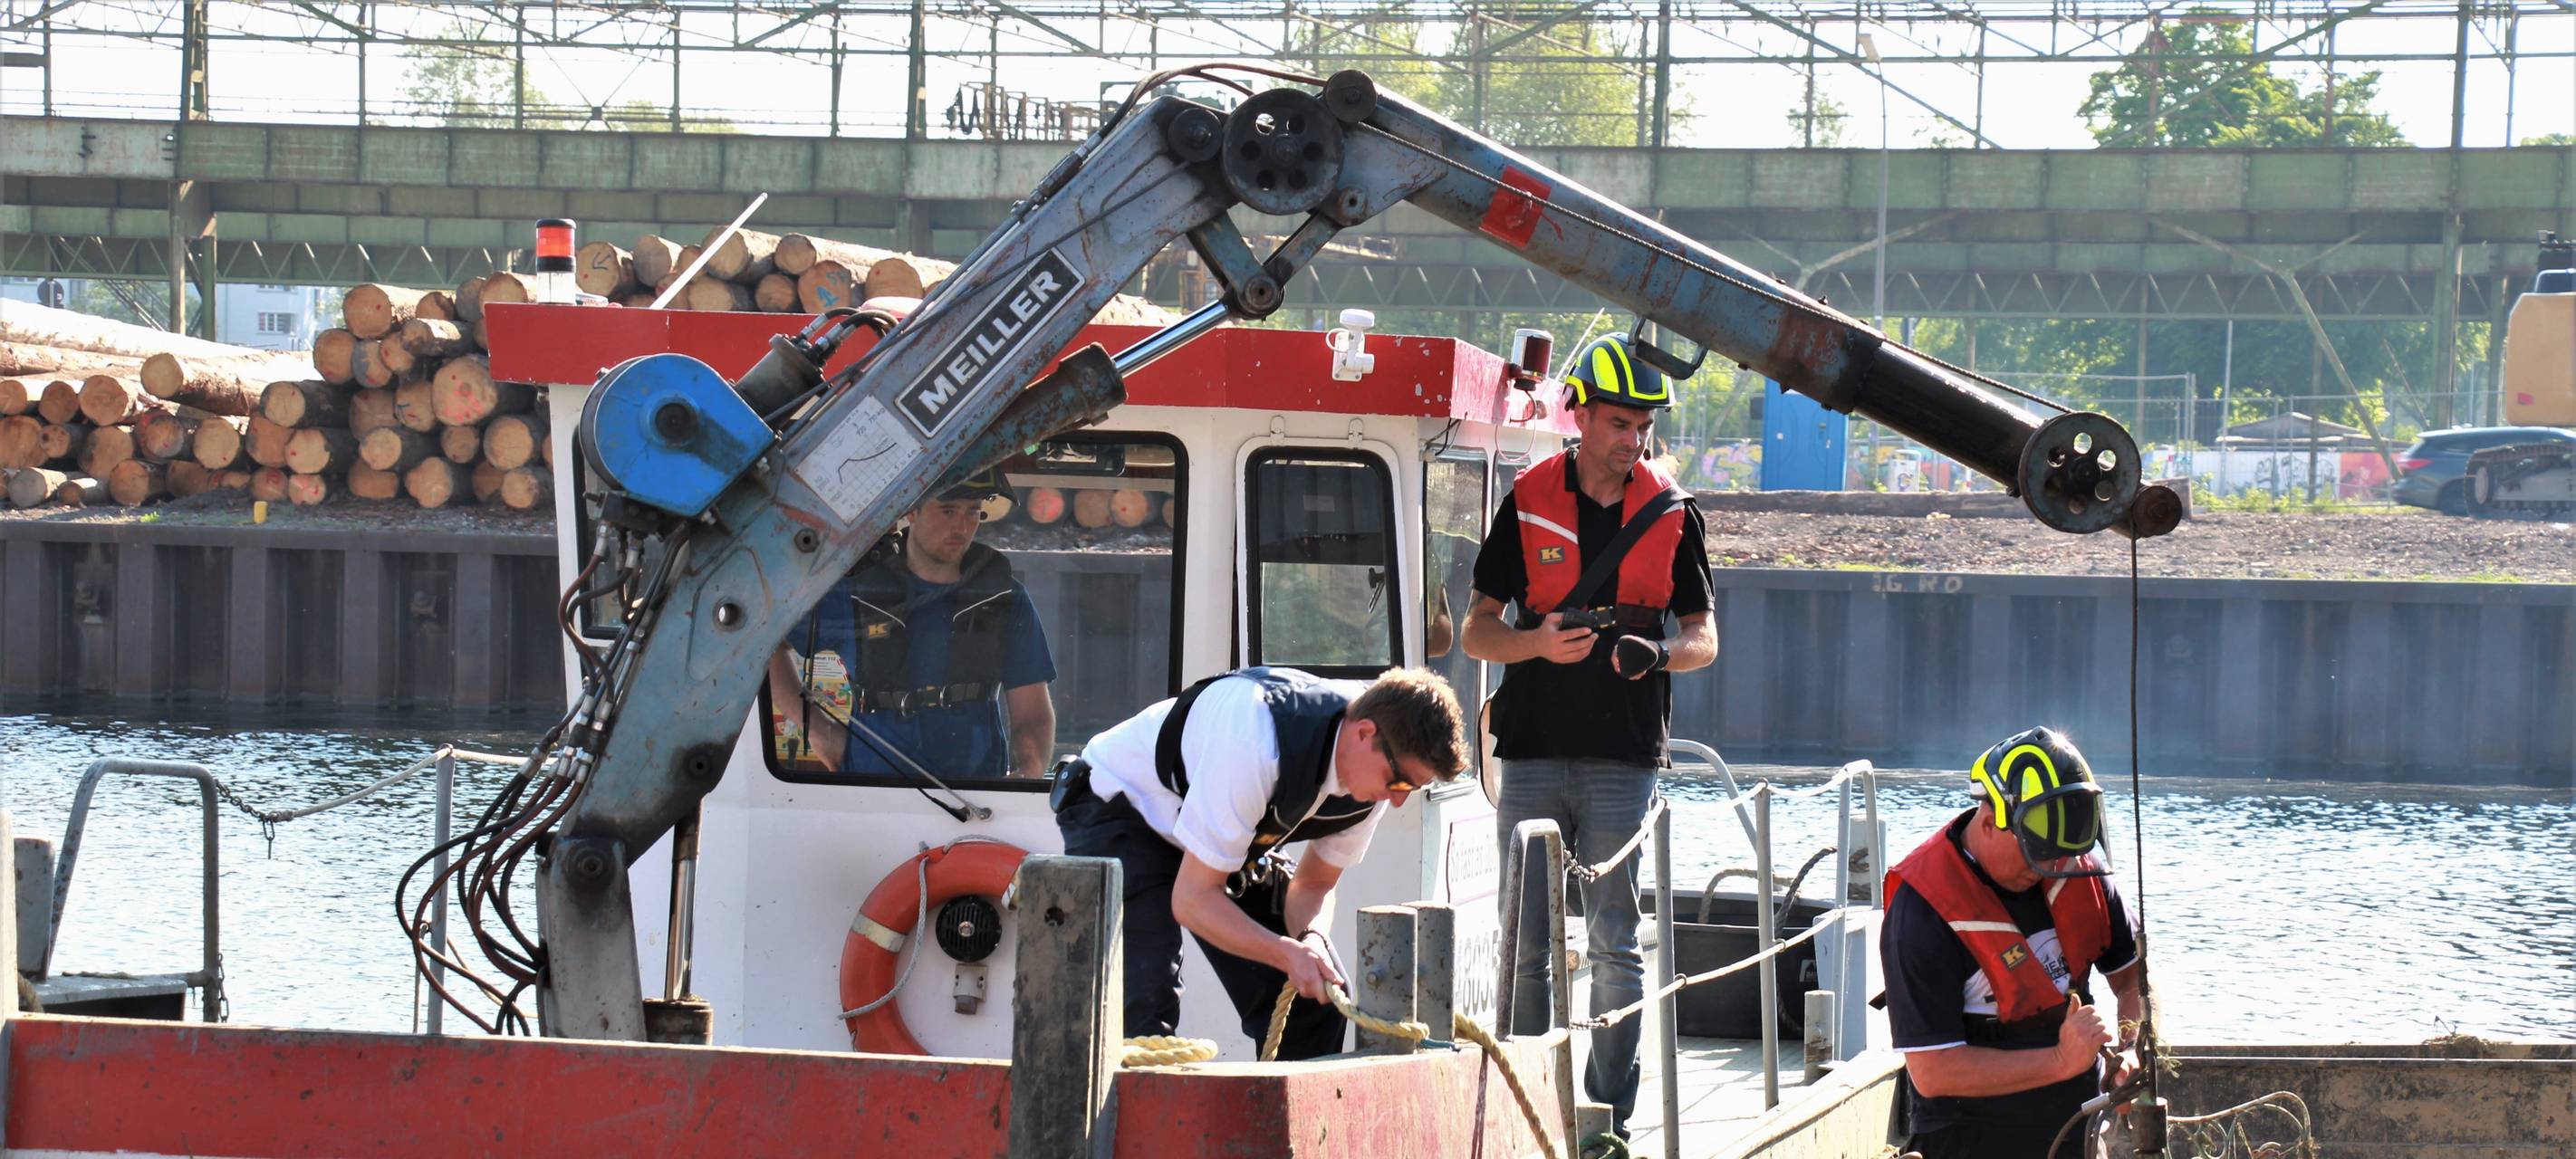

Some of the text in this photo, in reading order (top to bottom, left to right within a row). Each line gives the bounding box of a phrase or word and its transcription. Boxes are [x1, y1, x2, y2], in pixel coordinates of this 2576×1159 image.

[918, 271, 1062, 415] MEILLER
[1542, 547, 1562, 560] K
[869, 623, 888, 635] K
[2002, 944, 2025, 965] K
